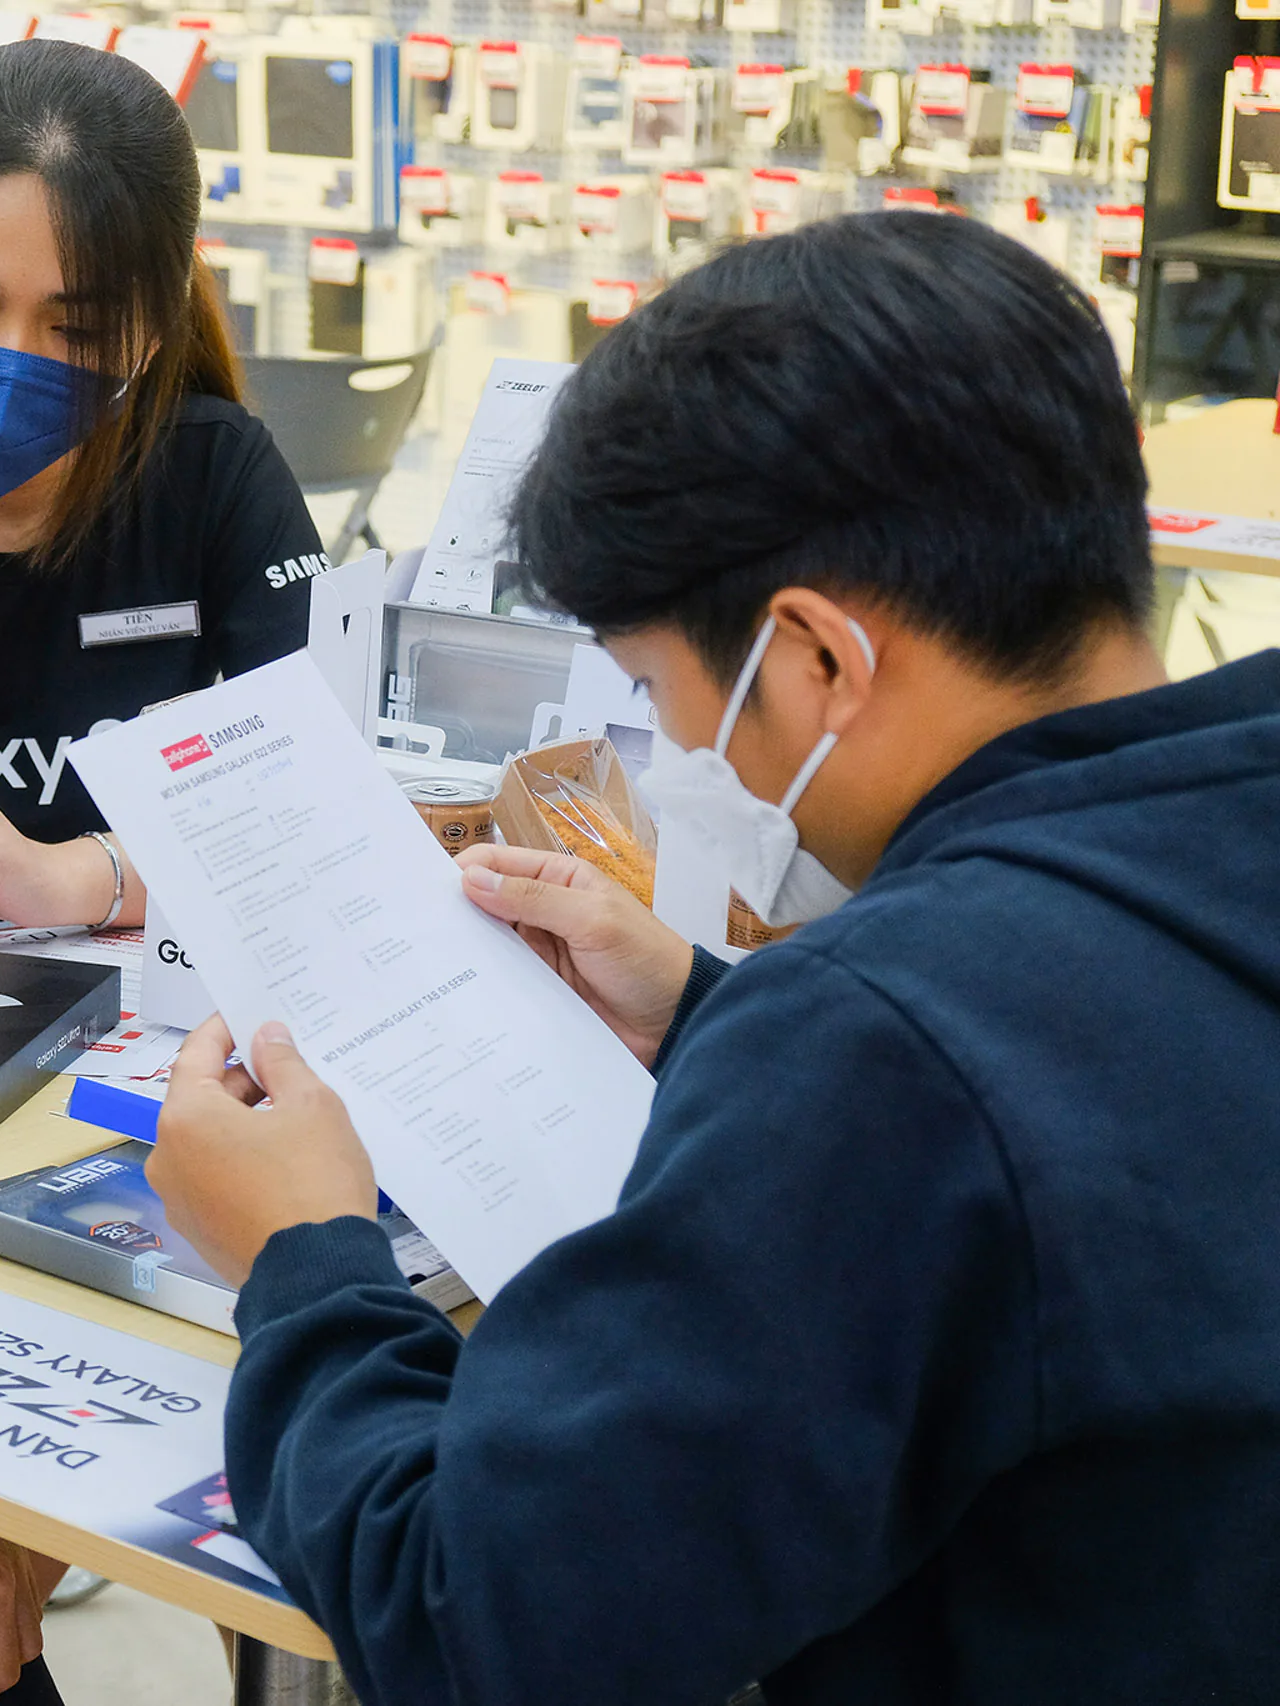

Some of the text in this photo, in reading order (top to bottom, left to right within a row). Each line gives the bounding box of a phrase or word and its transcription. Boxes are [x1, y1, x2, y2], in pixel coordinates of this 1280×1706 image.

[208, 714, 265, 749] SAMSUNG
[189, 763, 227, 789] SAMSUNG
[224, 751, 255, 773] GALAXY
[267, 735, 295, 754] SERIES
[354, 1018, 395, 1047] SAMSUNG
[392, 999, 425, 1024] GALAXY
[447, 968, 478, 990] SERIES
[35, 1043, 58, 1069] Galaxy
[34, 1354, 202, 1413] GALAXY
